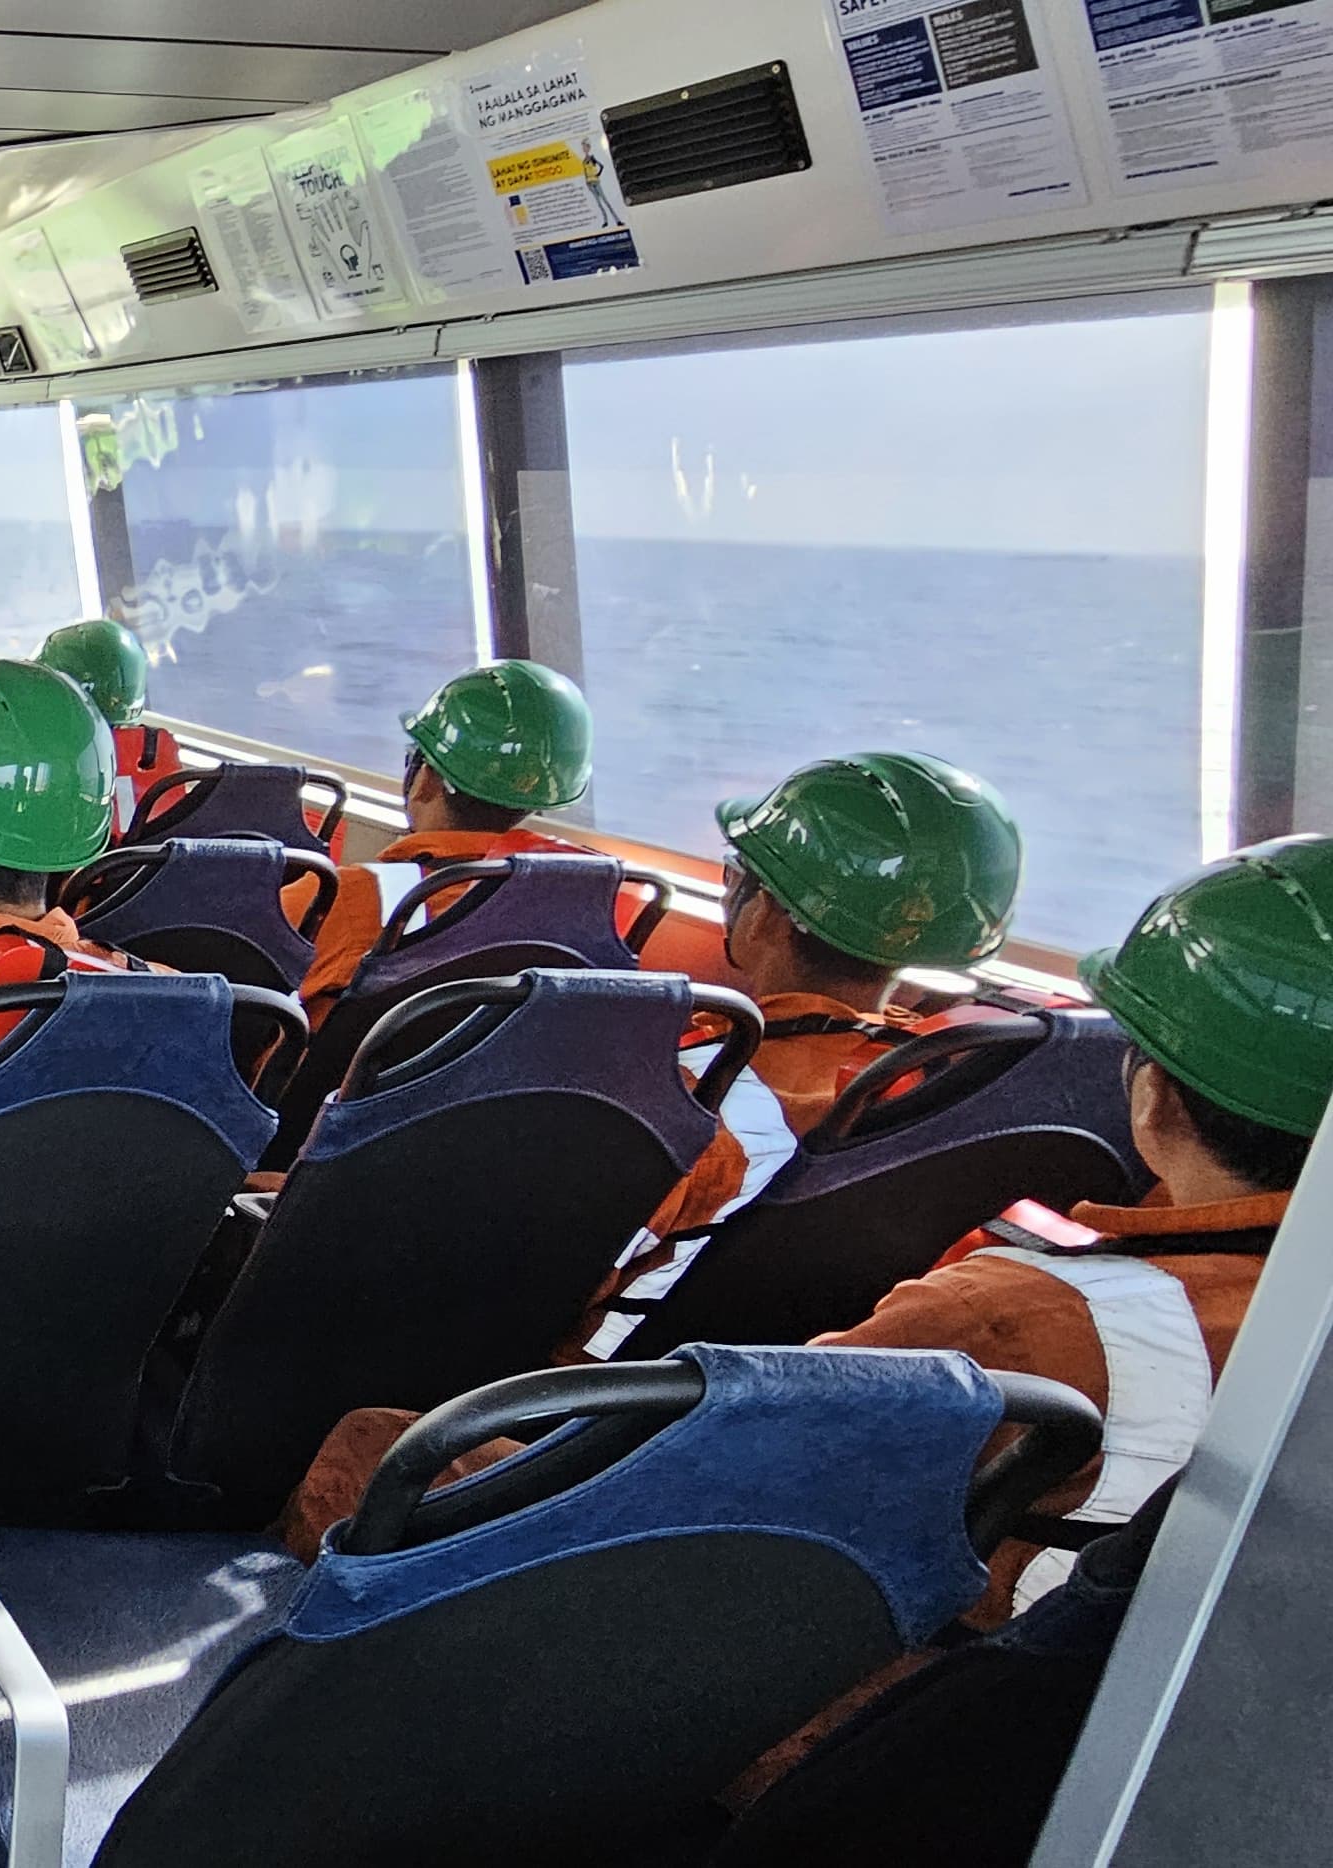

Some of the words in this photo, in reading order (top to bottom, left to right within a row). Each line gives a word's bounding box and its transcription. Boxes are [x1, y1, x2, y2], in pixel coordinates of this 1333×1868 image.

[839, 0, 887, 15] SAF
[526, 85, 541, 98] SA
[543, 72, 578, 93] LAHAT
[479, 115, 496, 129] NG
